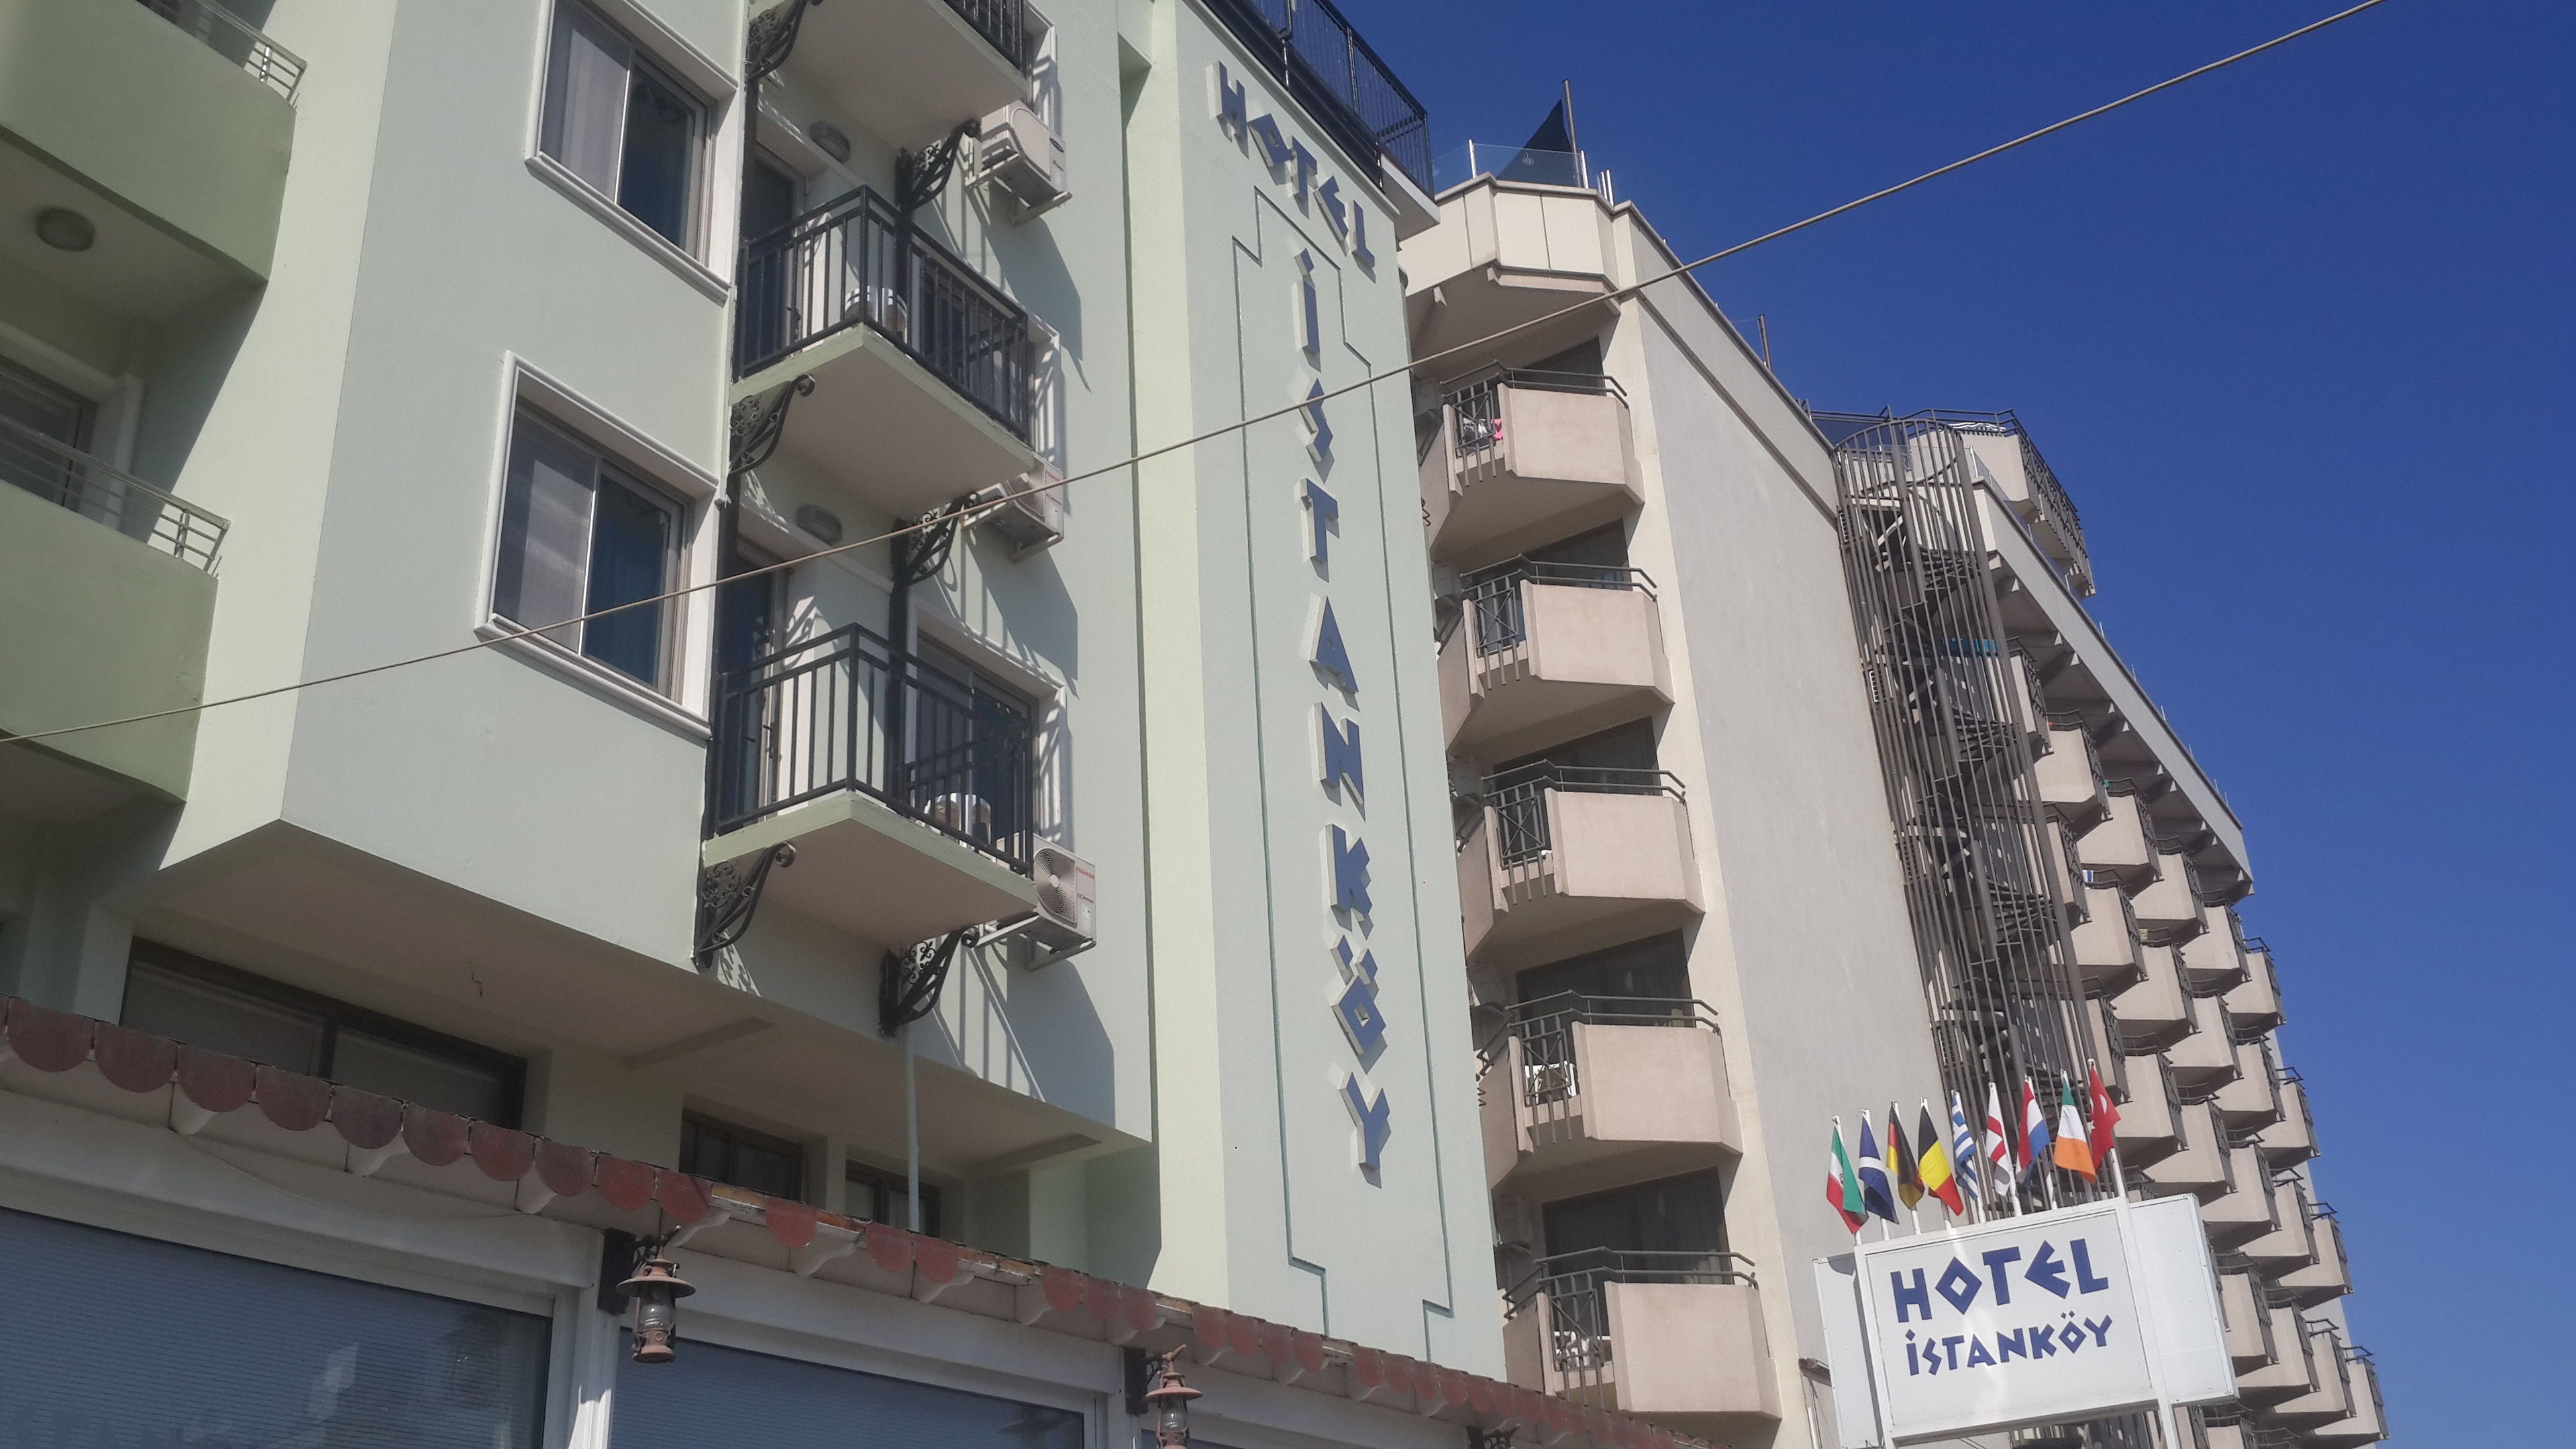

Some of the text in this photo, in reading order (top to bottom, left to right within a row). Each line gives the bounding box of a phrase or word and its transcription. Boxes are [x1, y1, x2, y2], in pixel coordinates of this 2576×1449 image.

[1213, 61, 1375, 266] HOTEL
[1294, 248, 1390, 1171] İSTANKÖY
[1890, 1238, 2109, 1323] HOTEL
[1906, 1310, 2113, 1376] İSTANKÖY
